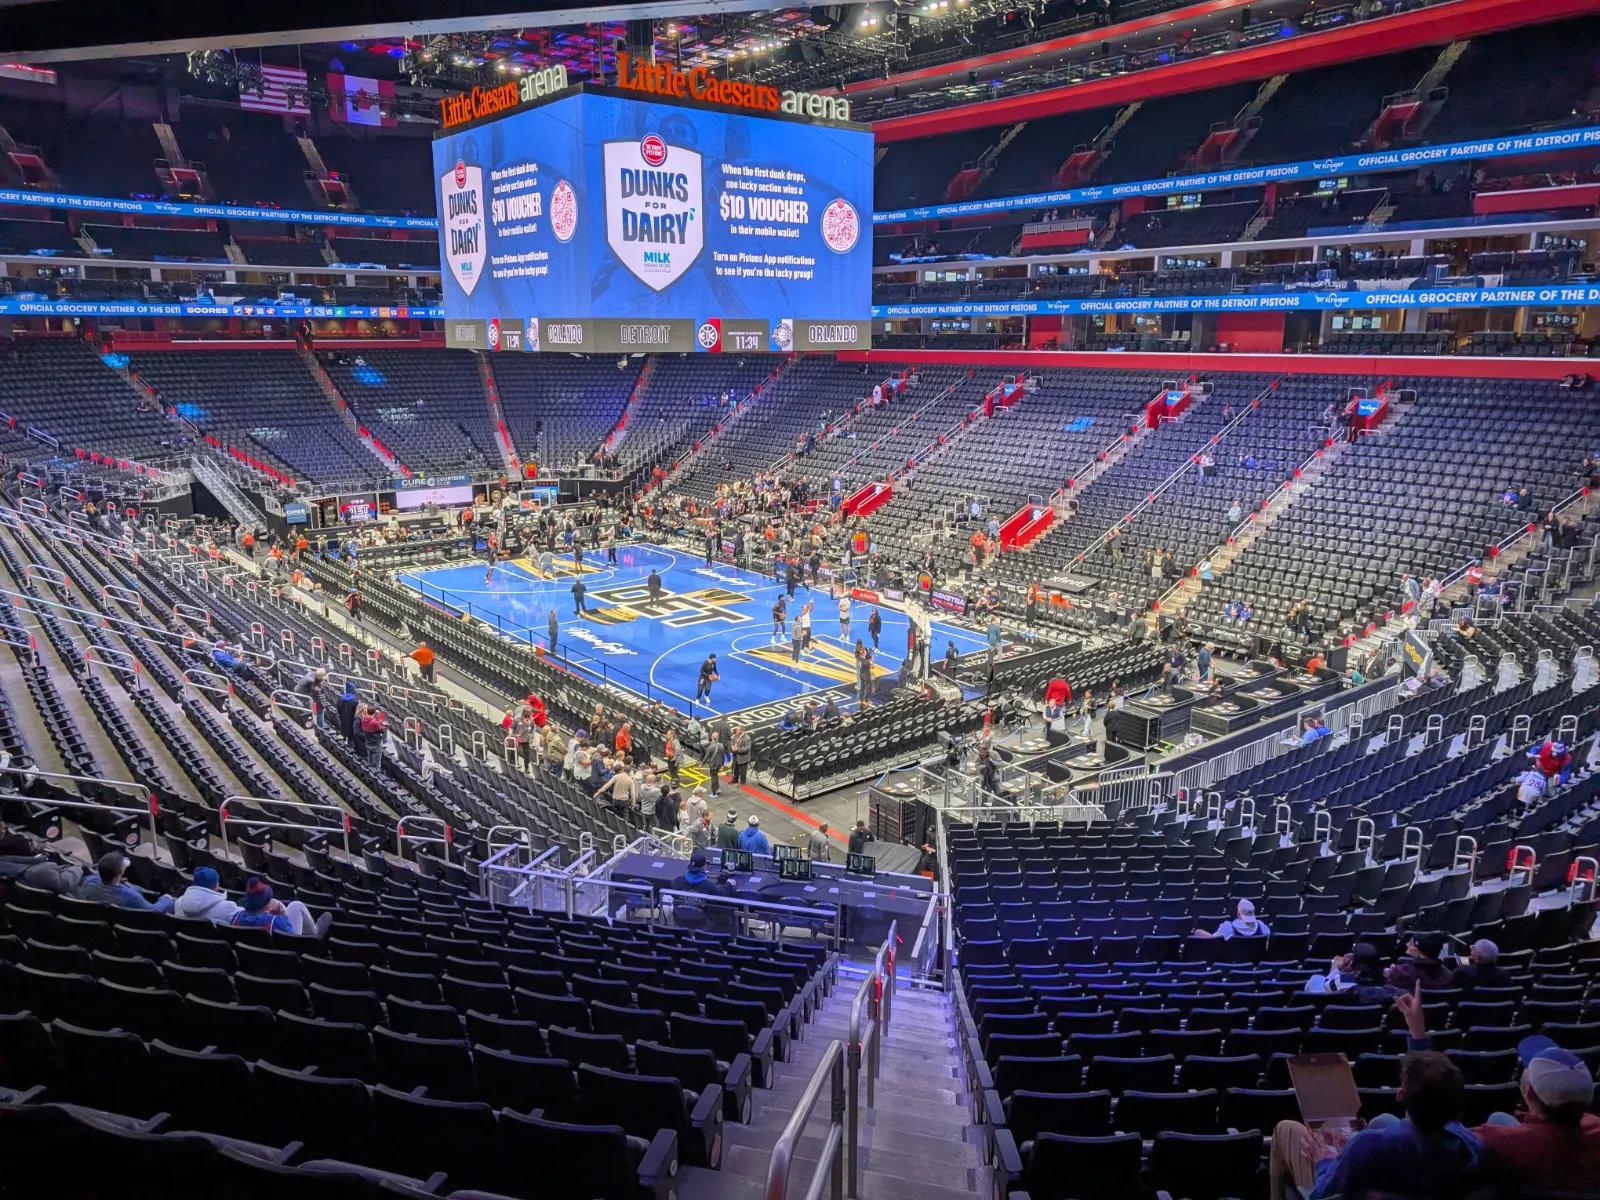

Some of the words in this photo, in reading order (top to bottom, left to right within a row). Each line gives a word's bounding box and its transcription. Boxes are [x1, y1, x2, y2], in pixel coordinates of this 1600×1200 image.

[616, 52, 686, 97] Little
[688, 66, 780, 111] Caesars
[781, 89, 850, 121] arena
[440, 92, 472, 128] Little
[471, 81, 519, 119] Caesars
[520, 64, 568, 102] arena
[1358, 154, 1399, 166] OFFICIAL
[1401, 148, 1448, 162] GROCERY
[1451, 144, 1494, 156] PARTNER
[1496, 140, 1512, 150] OF
[1514, 138, 1533, 149] THE
[1535, 132, 1581, 147] DETROIT
[1322, 158, 1344, 172] Kroger
[722, 164, 741, 174] When
[742, 166, 753, 176] the
[755, 168, 769, 178] first
[770, 168, 785, 180] dunk
[787, 170, 806, 183] drops,
[1113, 185, 1140, 195] OFFICIAL
[1142, 181, 1175, 192] GROCERY
[1176, 178, 1205, 187] PARTNER
[1207, 176, 1218, 184] OF
[1219, 173, 1232, 182] THE
[1233, 170, 1265, 180] DETROIT
[1266, 166, 1298, 177] PISTONS
[620, 168, 688, 202] DUNKS
[726, 180, 738, 188] one
[739, 180, 757, 192] lucky
[759, 182, 781, 193] section
[783, 184, 798, 194] wins
[22, 194, 54, 203] PARTNER
[83, 199, 112, 208] DETROIT
[113, 202, 142, 210] PISTONS
[448, 189, 478, 220] DUNKS
[492, 198, 505, 226] $10
[506, 192, 542, 220] VOUCHER
[645, 202, 666, 210] FOR
[720, 192, 745, 221] $10
[748, 197, 809, 224] VOUCHER
[937, 206, 958, 215] OFFICIAL
[959, 204, 982, 212] GROCERY
[983, 201, 1005, 209] PARTNER
[1025, 196, 1047, 204] DETROIT
[1048, 193, 1071, 202] PISTONS
[194, 207, 225, 215] OFFICIAL
[888, 212, 906, 220] PISTONS
[622, 208, 688, 244] DAIRY
[730, 224, 737, 234] in
[738, 225, 753, 235] their
[755, 226, 776, 237] mobile
[777, 228, 800, 238] wallet!
[451, 224, 479, 256] DAIRY
[644, 252, 670, 263] MILK
[713, 251, 728, 262] Turn
[739, 252, 762, 263] Pistons
[764, 254, 776, 266] App
[777, 254, 815, 266] notifications
[460, 262, 472, 272] MILK
[716, 266, 722, 275] to
[724, 268, 736, 276] see
[737, 266, 742, 276] if
[743, 267, 763, 278] you're
[764, 268, 775, 277] the
[776, 268, 792, 280] lucky
[793, 270, 813, 280] group!
[1080, 301, 1113, 311] OFFICIAL
[1114, 300, 1152, 310] GROCERY
[1154, 300, 1189, 309] PARTNER
[1191, 300, 1203, 308] OF
[1204, 299, 1220, 308] THE
[1222, 298, 1257, 308] DETROIT
[1260, 297, 1300, 307] PISTONS
[1325, 293, 1350, 307] Kroger
[1366, 293, 1416, 305] OFFICIAL
[1419, 291, 1477, 304] GROCERY
[1481, 290, 1535, 302] PARTNER
[1539, 289, 1558, 301] OF
[1560, 289, 1585, 300] THE
[20, 304, 54, 312] OFFICIAL
[56, 305, 97, 313] GROCERY
[100, 305, 135, 313] PARTNER
[1011, 304, 1037, 312] PISTONS
[548, 324, 583, 344] ORLANDO
[620, 324, 671, 344] DETROIT
[808, 324, 858, 343] ORLANDO
[736, 336, 758, 350] 11:34
[585, 584, 754, 628] DET
